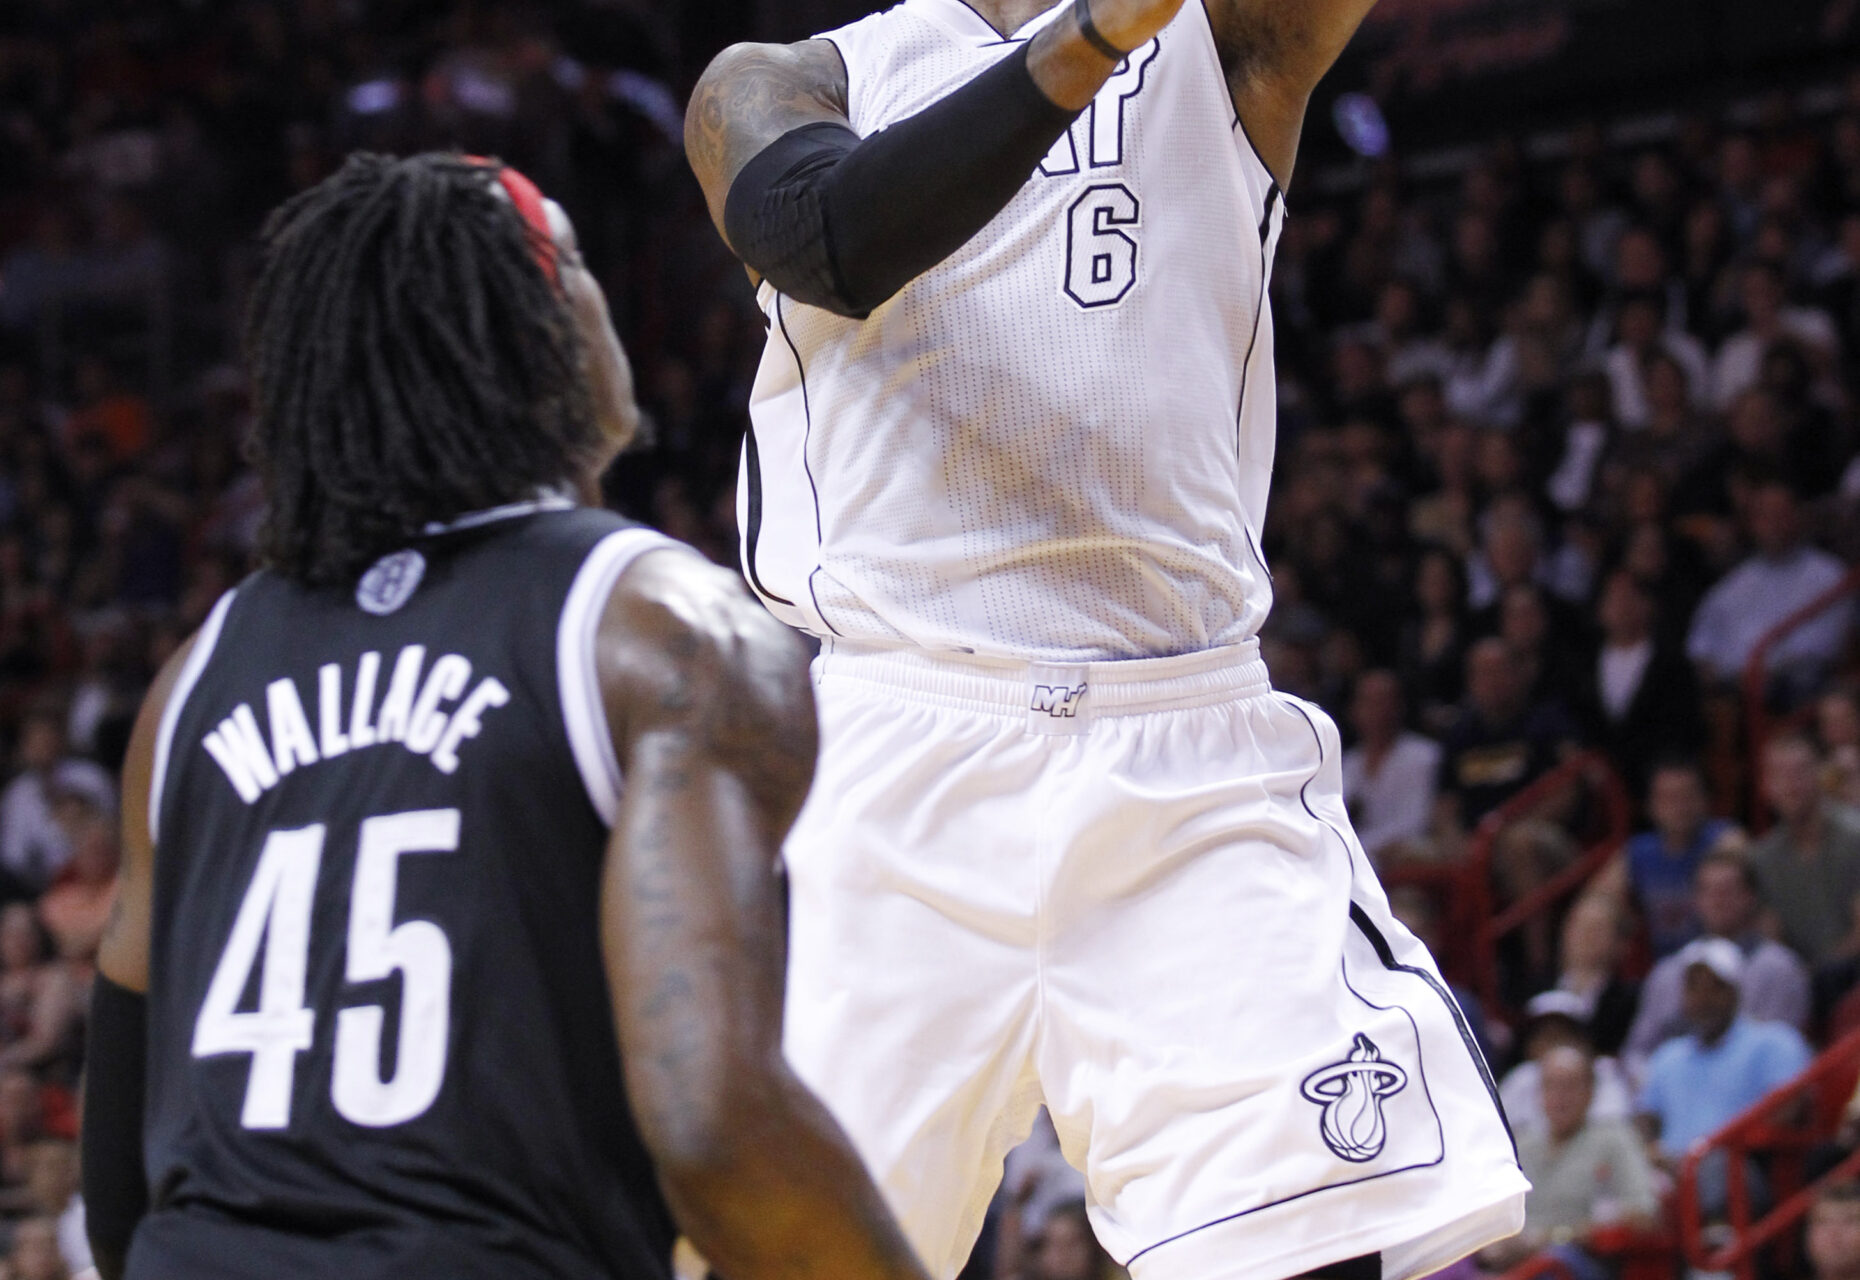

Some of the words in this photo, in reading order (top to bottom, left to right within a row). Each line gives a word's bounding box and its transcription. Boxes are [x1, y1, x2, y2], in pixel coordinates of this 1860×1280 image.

[1063, 182, 1140, 310] 6
[203, 644, 511, 803] WALLACE
[192, 808, 461, 1130] 45
